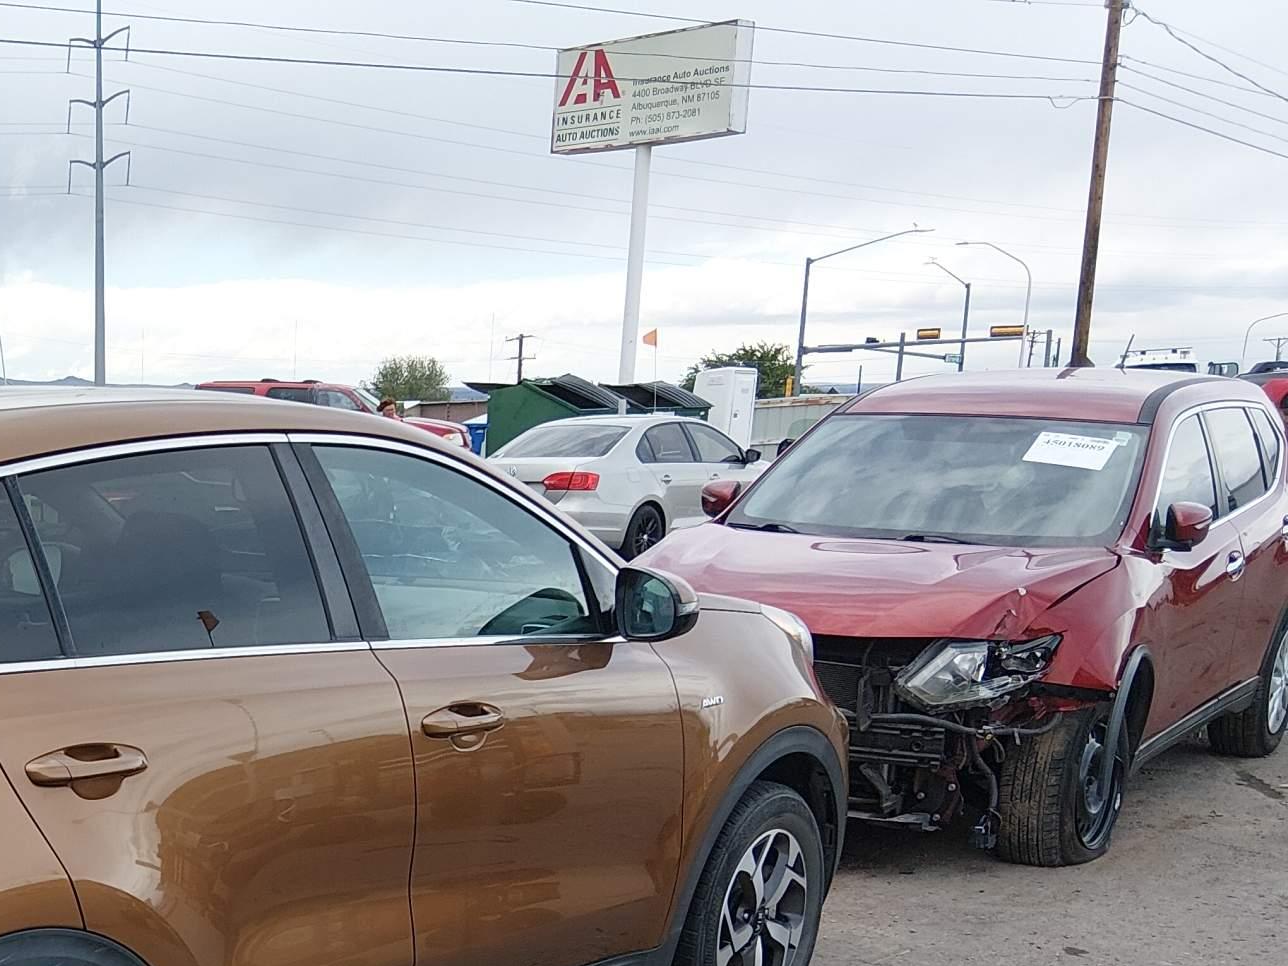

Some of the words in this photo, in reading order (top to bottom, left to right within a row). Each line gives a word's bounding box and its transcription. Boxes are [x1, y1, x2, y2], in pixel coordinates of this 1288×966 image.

[632, 74, 671, 86] Insurance
[672, 71, 691, 80] Auto
[693, 65, 730, 76] Auctions
[632, 88, 650, 98] 4400
[652, 84, 688, 96] Broadway
[690, 79, 712, 90] BLVD
[631, 98, 679, 111] Albuquerque,
[681, 95, 695, 104] NM
[696, 91, 720, 102] 87105
[557, 109, 621, 126] INSURANCE
[645, 113, 664, 125] (505)
[666, 108, 701, 121] 873-2081
[556, 132, 577, 143] AUTO
[579, 126, 620, 140] AUCTIONS
[629, 125, 679, 137] www.iaai.com
